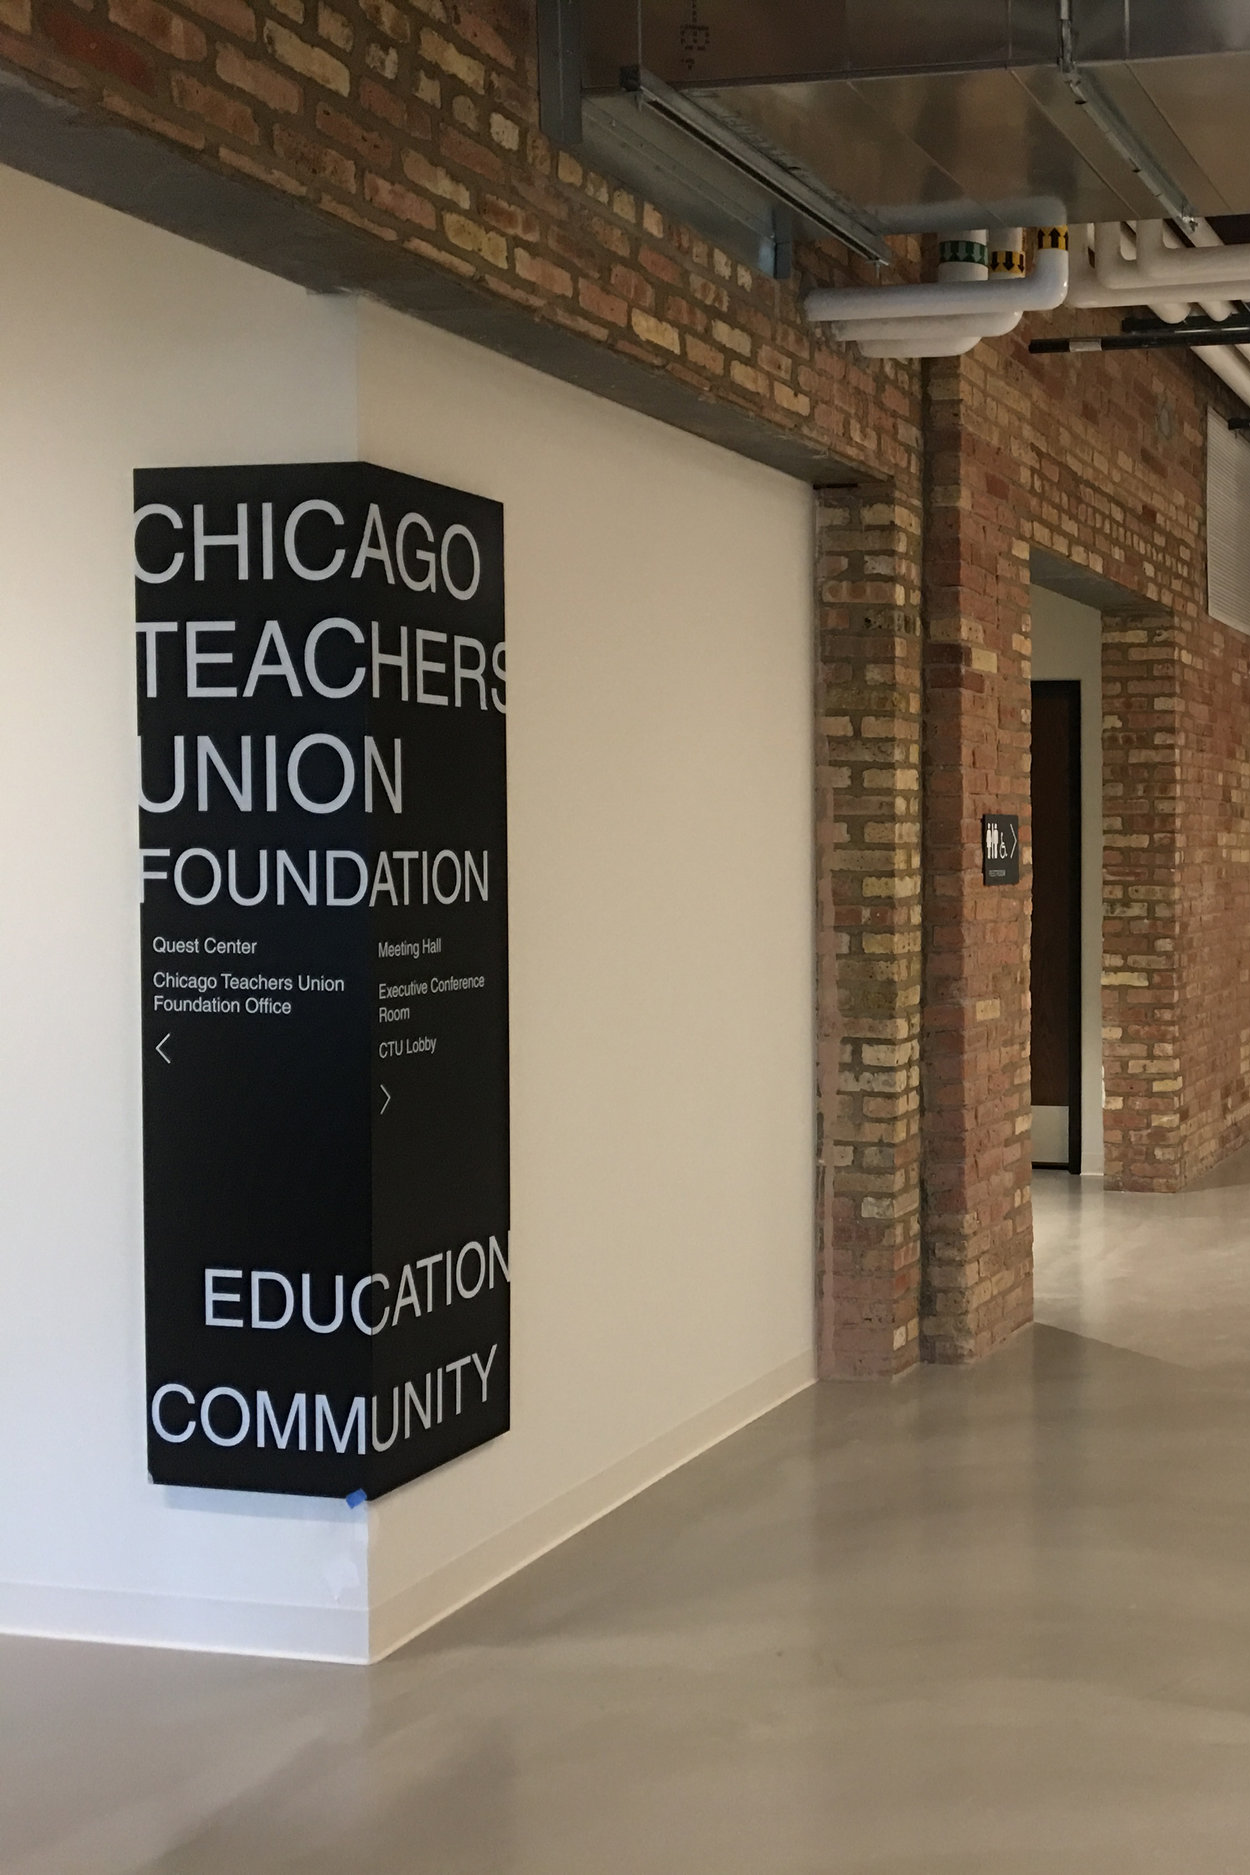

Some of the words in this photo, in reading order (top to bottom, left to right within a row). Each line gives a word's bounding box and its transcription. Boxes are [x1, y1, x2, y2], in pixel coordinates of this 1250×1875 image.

[134, 499, 481, 601] CHICAGO
[135, 617, 507, 714] TEACHERS
[137, 733, 403, 814] UNION
[139, 847, 489, 907] FOUNDATION
[152, 936, 200, 954] Quest
[203, 937, 258, 954] Center
[378, 940, 420, 959] Meeting
[422, 938, 442, 954] Hall
[152, 971, 218, 993] Chicago
[220, 973, 294, 991] Teachers
[298, 975, 345, 992] Union
[378, 980, 429, 1000] Executive
[430, 975, 485, 994] Conference
[153, 995, 241, 1014] Foundation
[244, 996, 292, 1015] Office
[379, 1006, 411, 1023] Room
[378, 1039, 404, 1059] CTU
[405, 1036, 437, 1055] Lobby
[204, 1230, 511, 1335] EDUCATION
[151, 1344, 498, 1455] COMMUNITY
